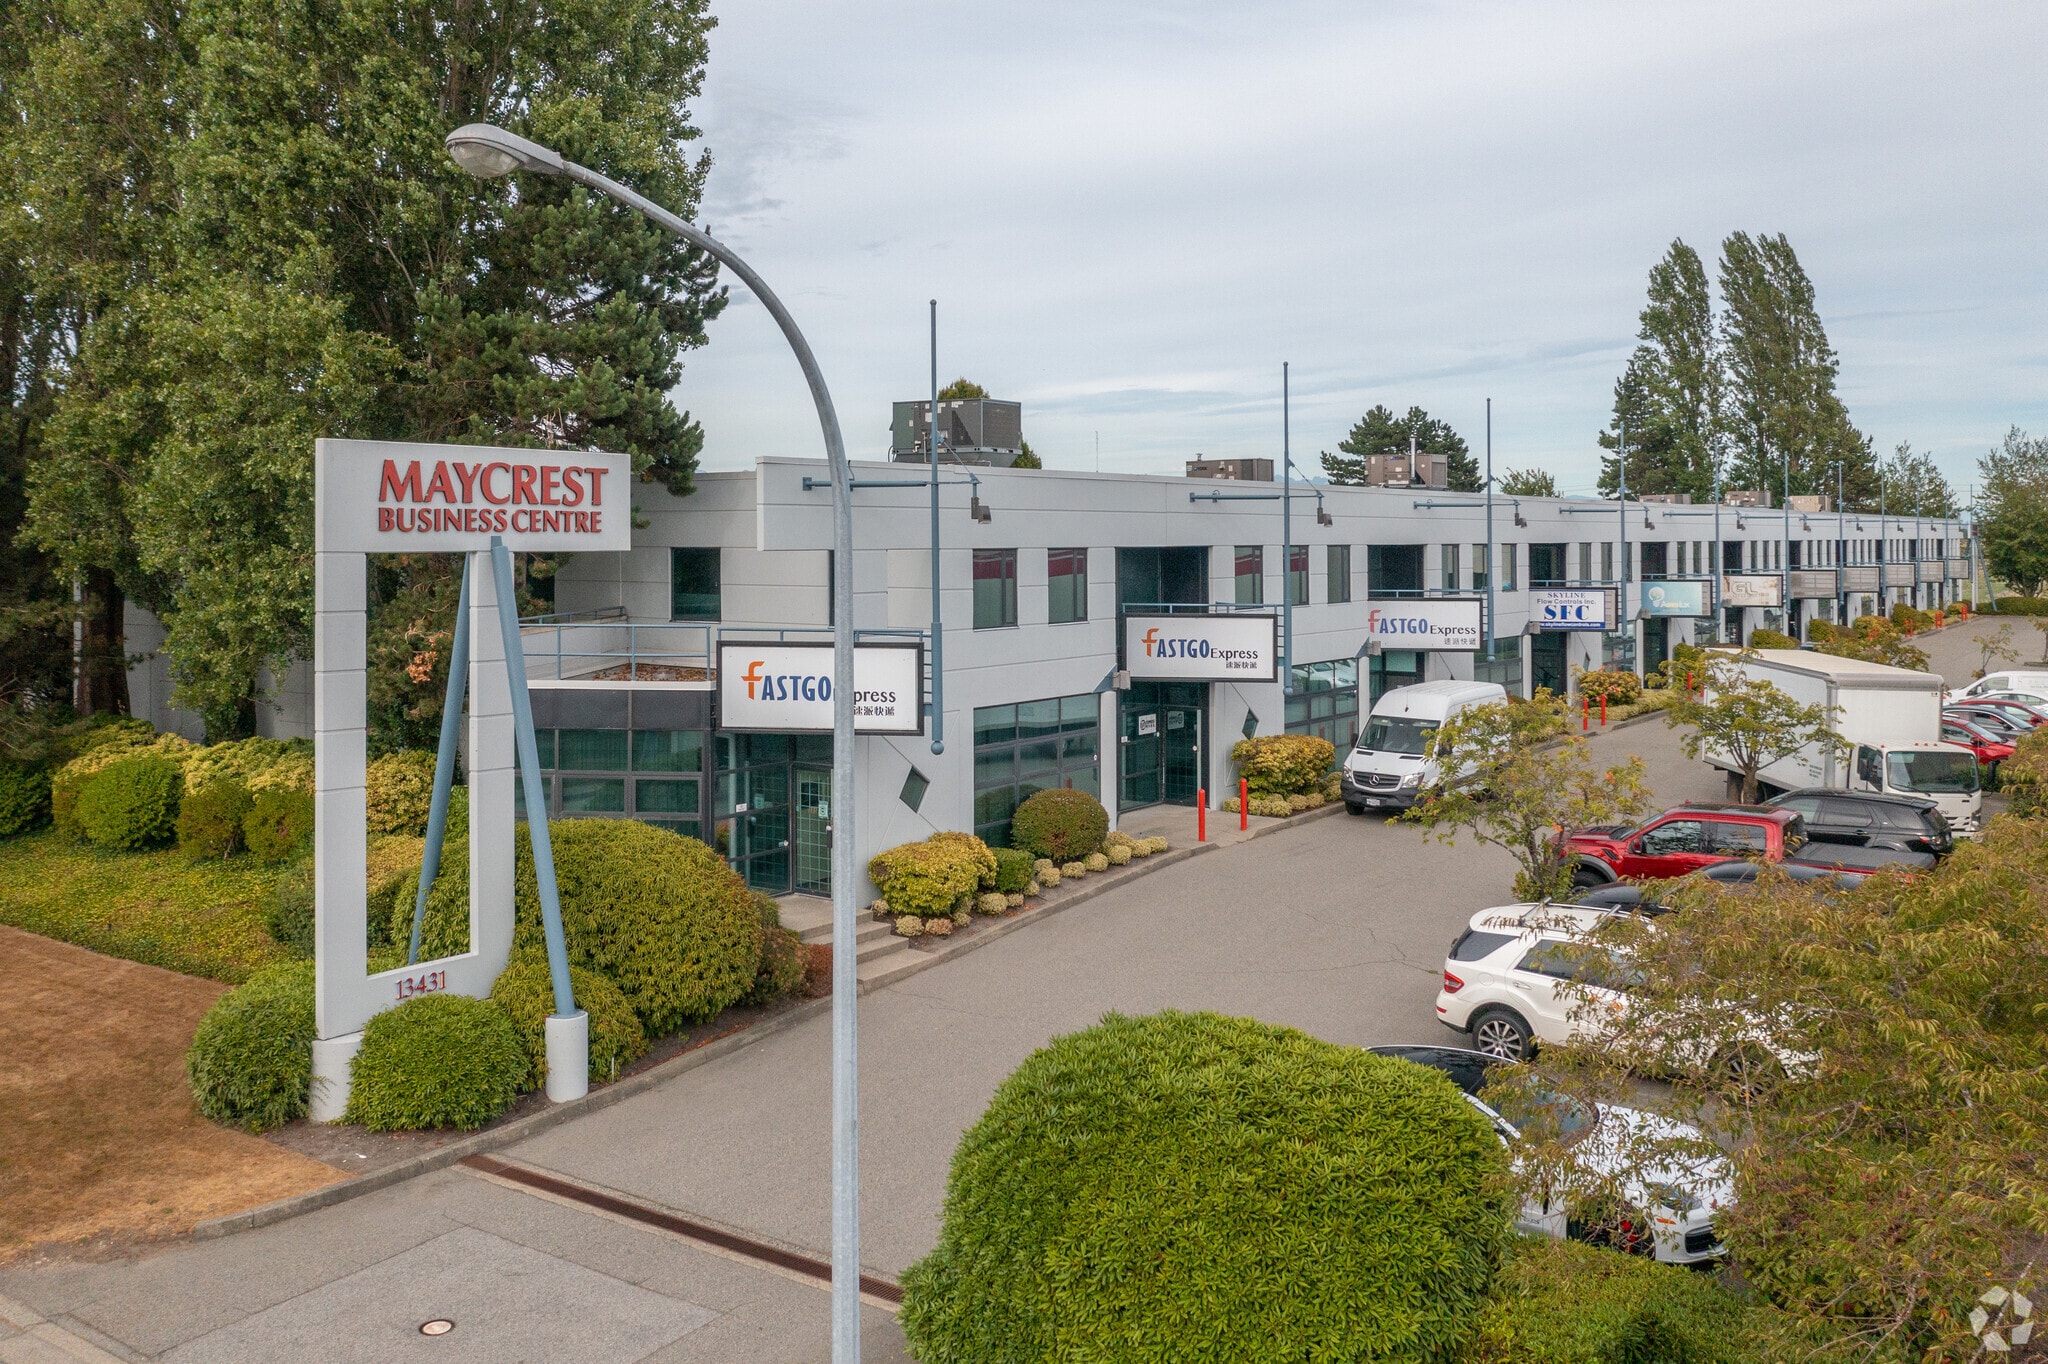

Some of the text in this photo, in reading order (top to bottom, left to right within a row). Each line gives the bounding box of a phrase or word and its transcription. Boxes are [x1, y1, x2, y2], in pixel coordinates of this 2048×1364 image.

[379, 459, 609, 506] MAYCREST
[378, 507, 602, 533] BUSINESS CENTRE
[1544, 605, 1589, 620] SFC
[1430, 625, 1476, 636] Express
[1210, 648, 1258, 660] Express
[834, 688, 896, 705] press
[395, 970, 446, 1000] 13431
